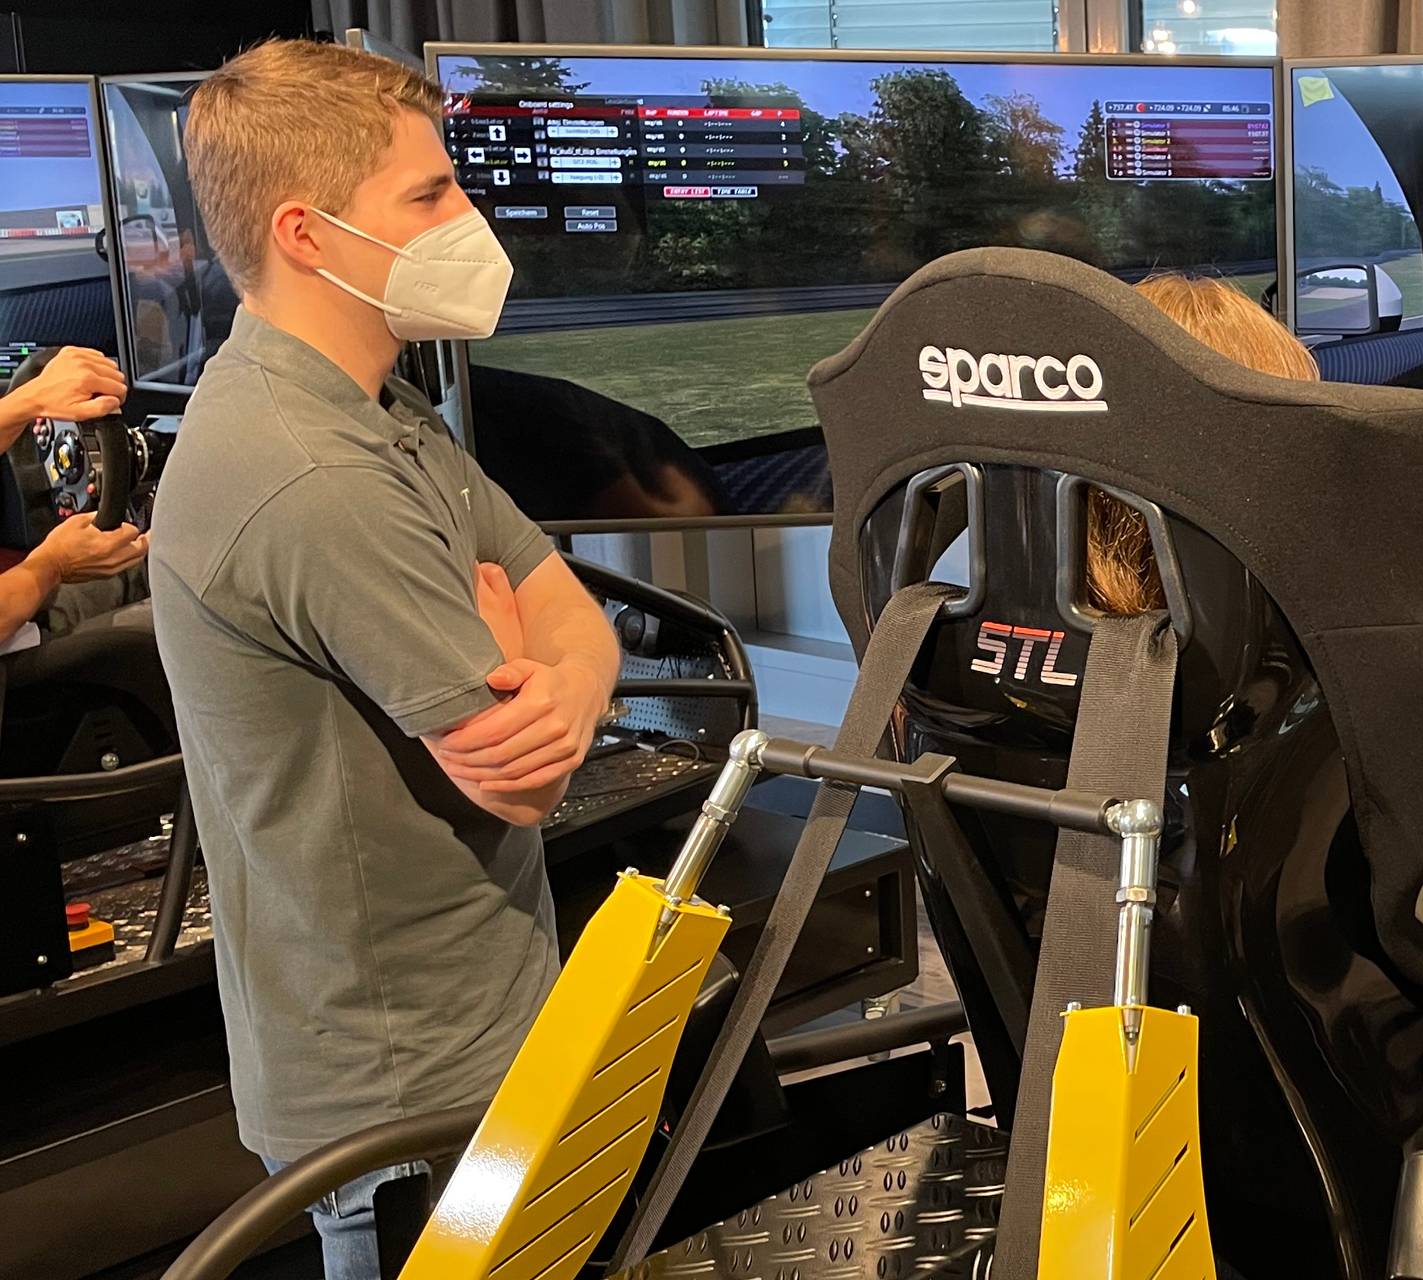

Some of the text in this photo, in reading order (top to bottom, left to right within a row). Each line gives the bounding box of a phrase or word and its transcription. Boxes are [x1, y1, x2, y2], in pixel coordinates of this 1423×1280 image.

[548, 100, 574, 110] settings
[919, 345, 1104, 408] sparco
[970, 621, 1078, 687] STL
